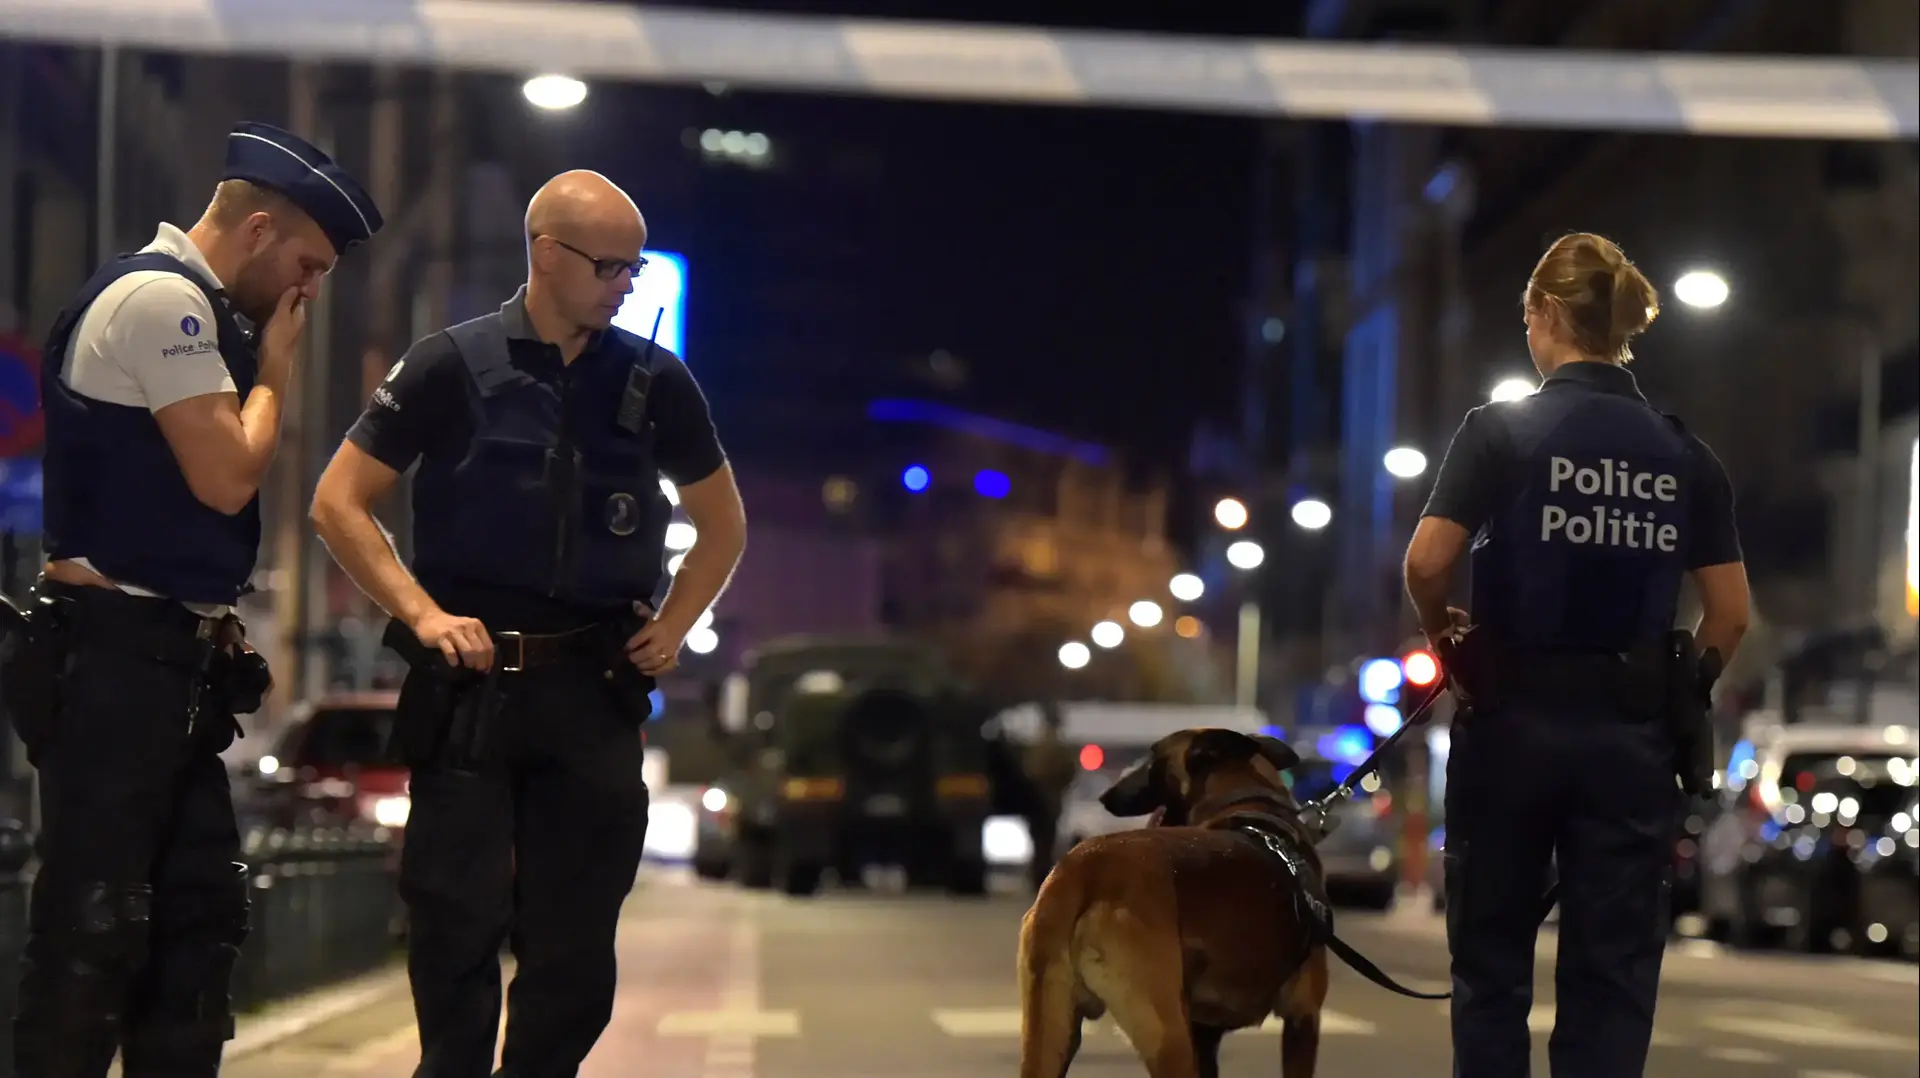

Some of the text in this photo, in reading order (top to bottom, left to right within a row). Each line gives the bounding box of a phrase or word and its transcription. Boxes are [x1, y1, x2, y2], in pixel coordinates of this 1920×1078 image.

[162, 344, 193, 358] Police
[1550, 456, 1677, 501] Police
[1541, 505, 1678, 552] Politie
